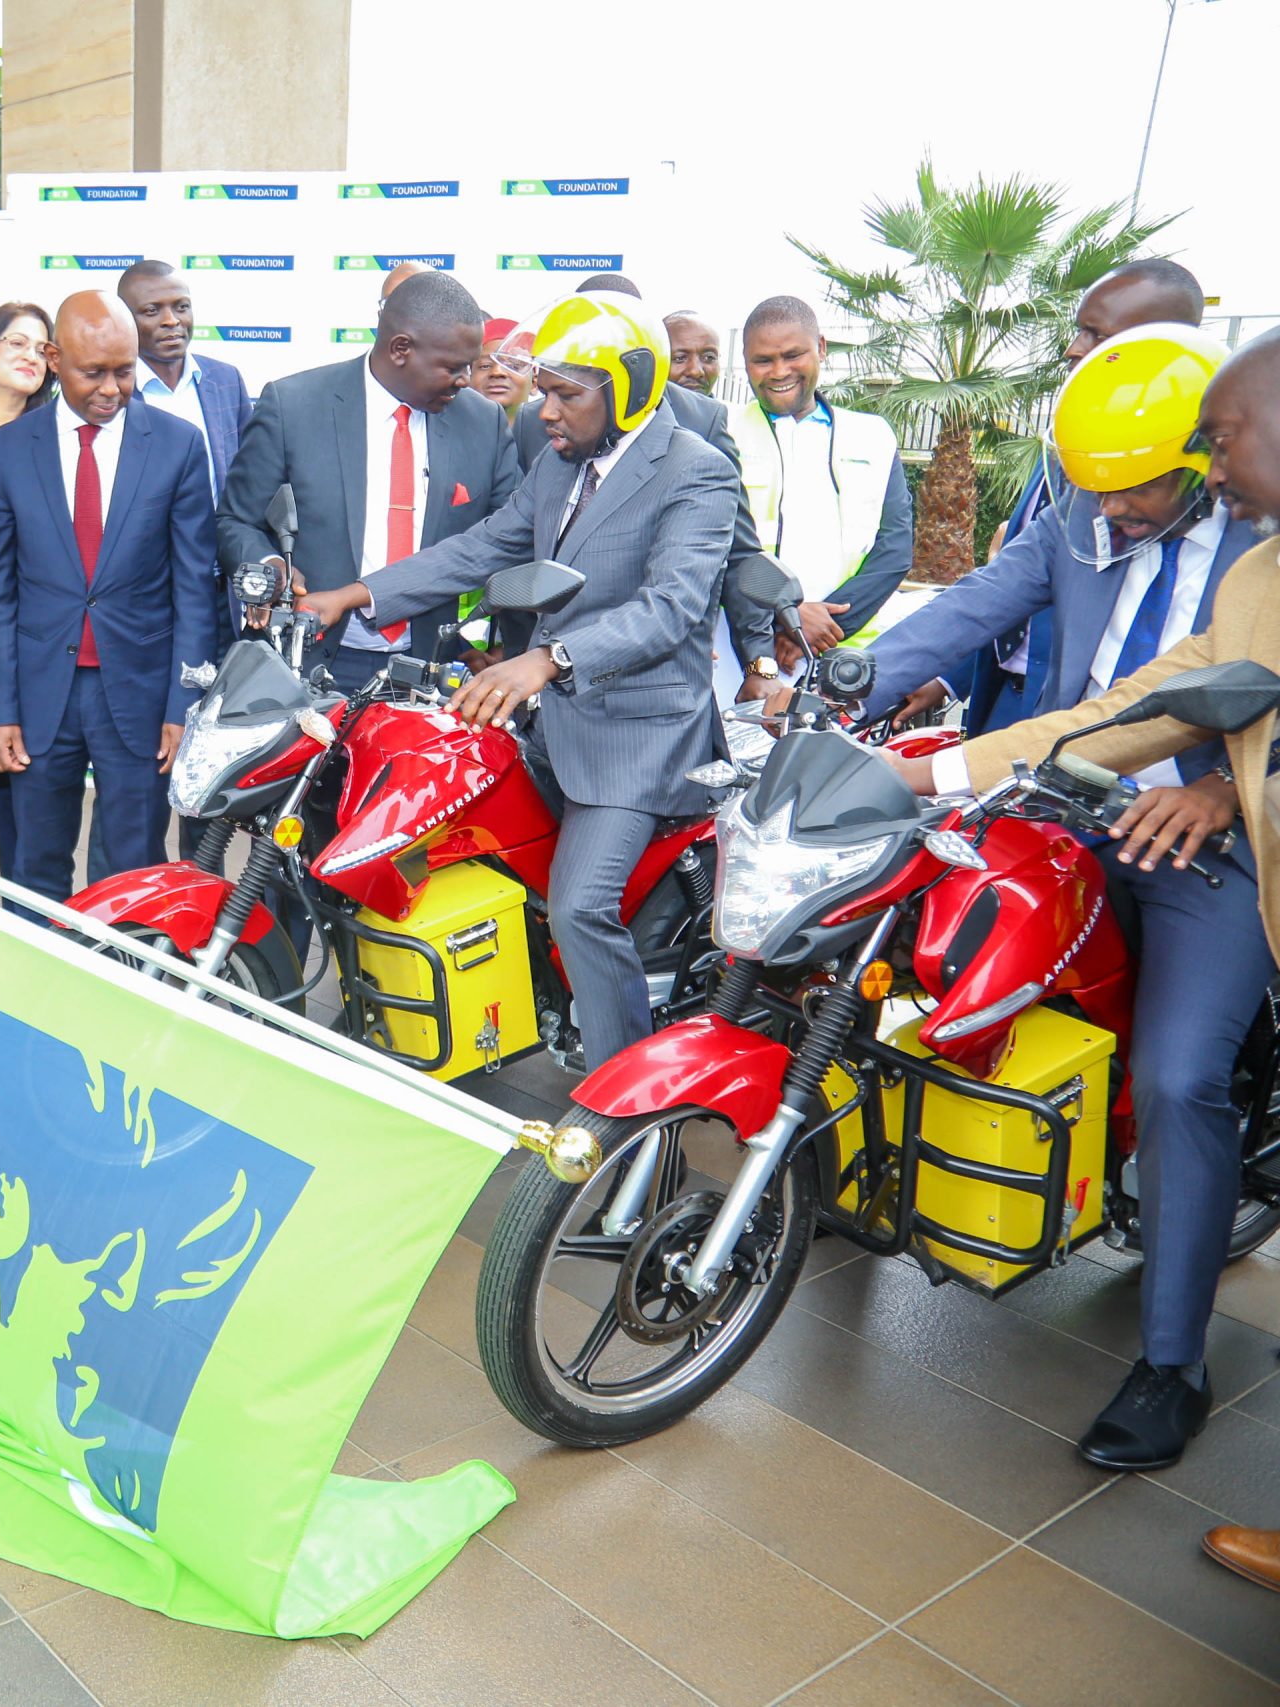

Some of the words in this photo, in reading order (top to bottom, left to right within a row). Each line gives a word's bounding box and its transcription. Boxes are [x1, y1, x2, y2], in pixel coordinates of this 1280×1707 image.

[392, 185, 449, 195] FOUNDATION
[558, 183, 618, 192] FOUNDATION
[87, 190, 138, 199] FOUNDATION
[235, 188, 288, 197] FOUNDATION
[86, 259, 136, 267] FOUNDATION
[231, 259, 285, 268] FOUNDATION
[553, 258, 612, 268] FOUNDATION
[229, 330, 282, 339] FOUNDATION
[416, 774, 496, 836] AMPERSAND
[1044, 895, 1103, 986] AMPERSAND
